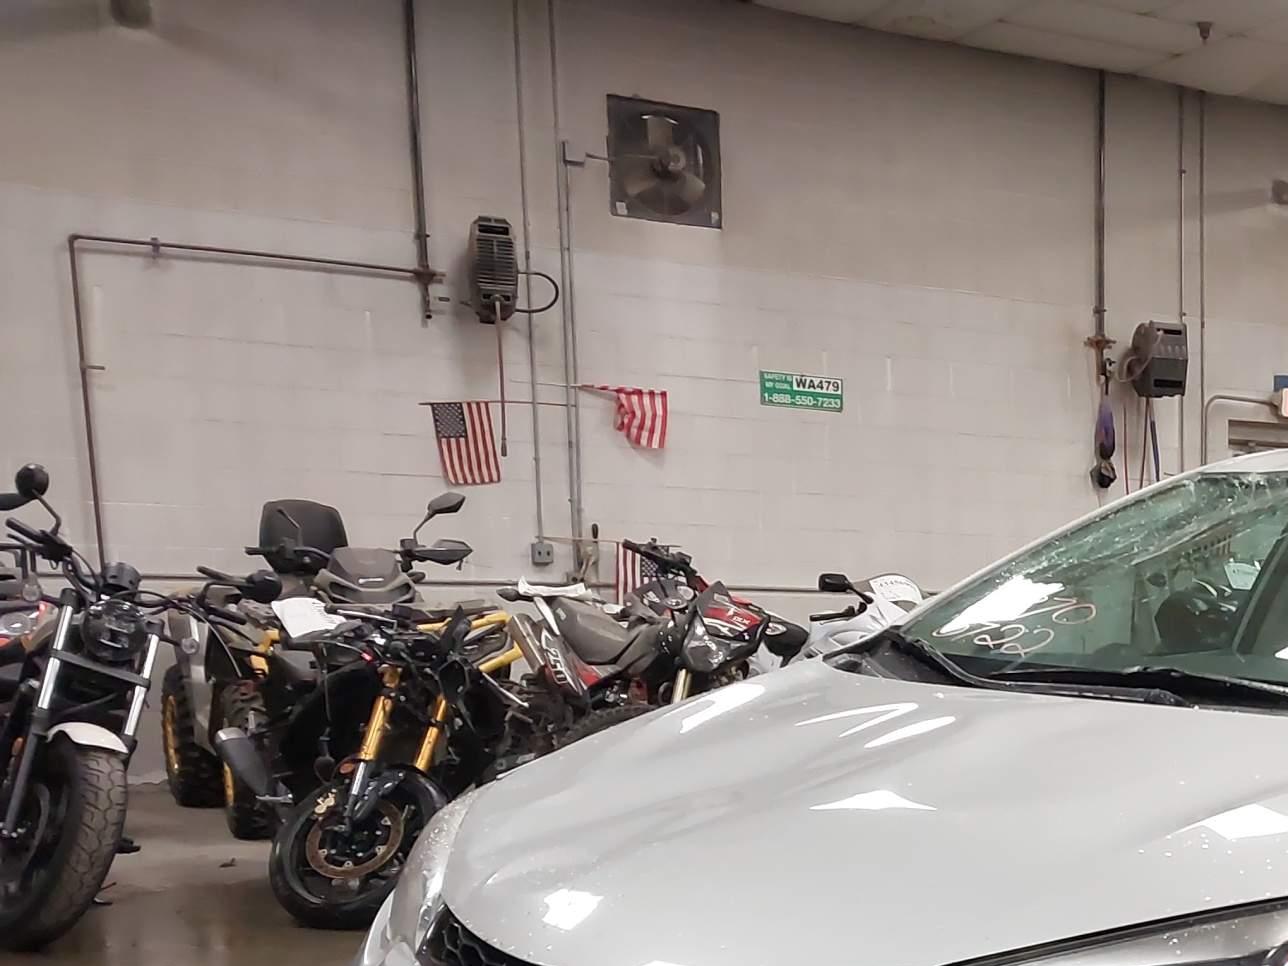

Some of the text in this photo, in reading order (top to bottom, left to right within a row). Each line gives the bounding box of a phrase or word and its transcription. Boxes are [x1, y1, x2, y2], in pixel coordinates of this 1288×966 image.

[795, 377, 840, 392] WA479
[764, 393, 841, 408] 1-888-550-7233
[545, 647, 570, 685] 250
